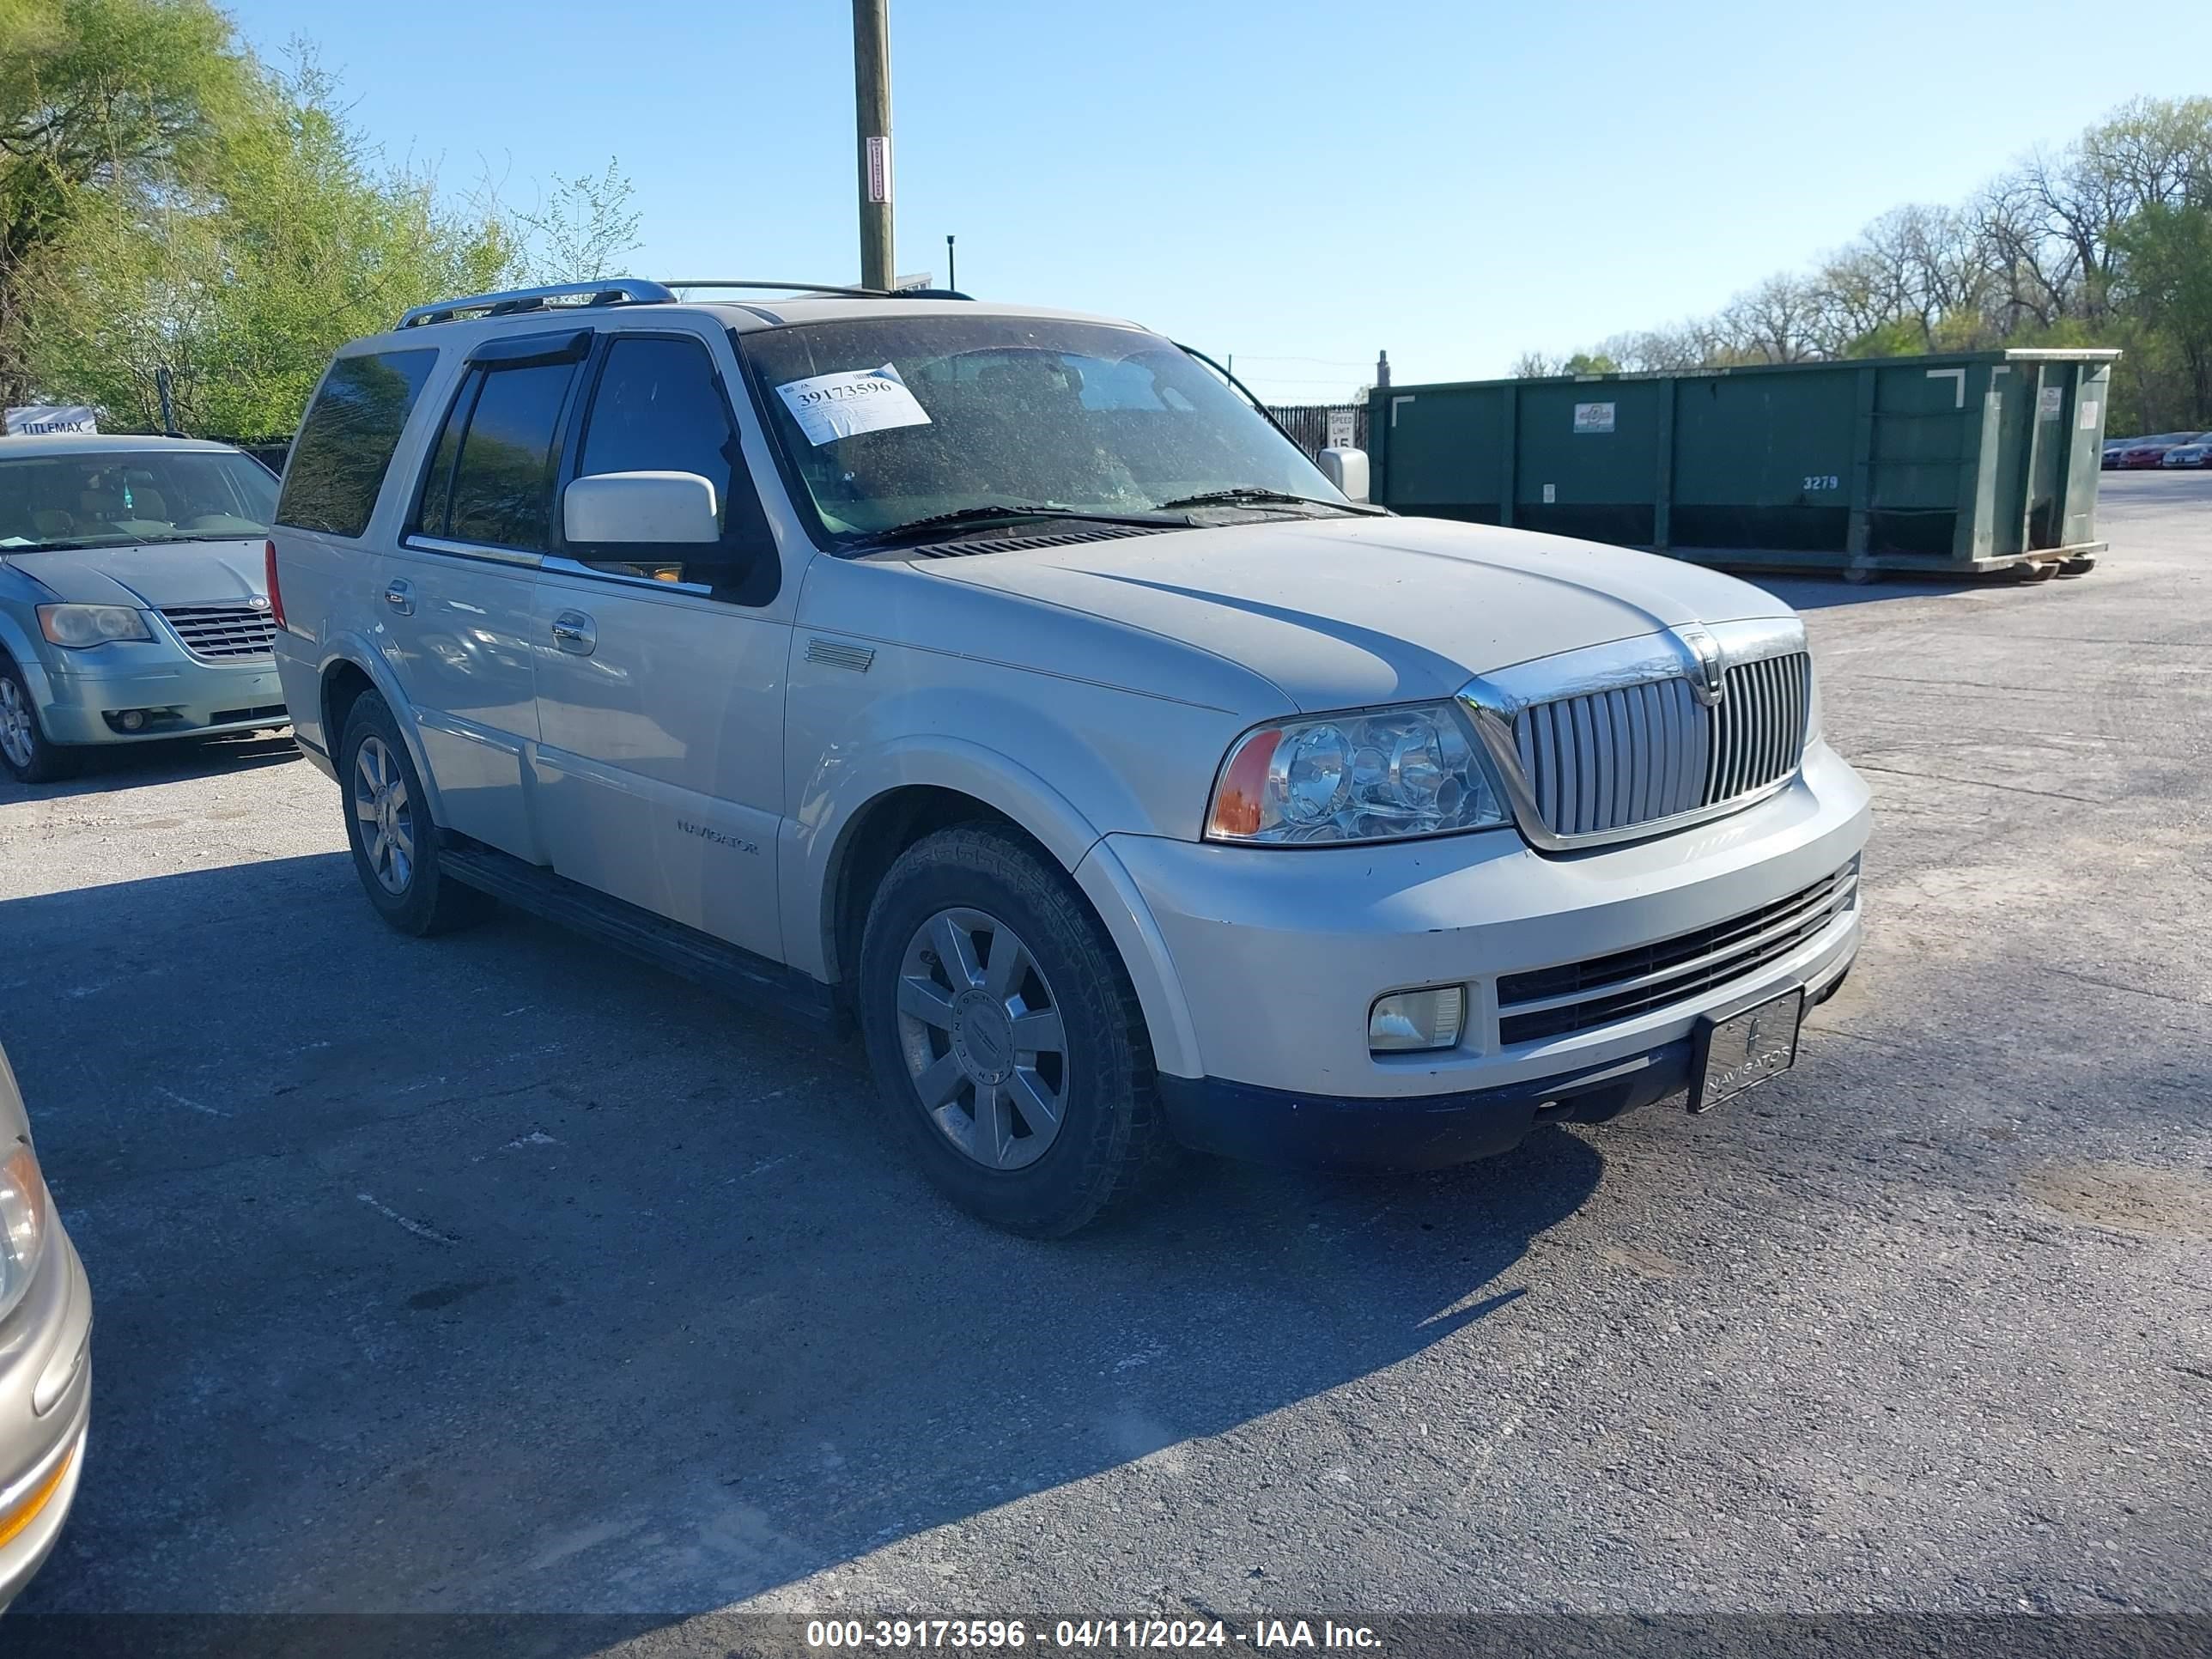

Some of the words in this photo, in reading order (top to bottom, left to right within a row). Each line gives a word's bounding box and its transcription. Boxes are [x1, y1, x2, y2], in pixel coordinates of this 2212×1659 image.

[798, 380, 892, 407] 39173596
[1331, 416, 1352, 425] SPEED
[21, 422, 83, 434] TITLEMAX
[1333, 427, 1349, 435] LIMIT
[1333, 438, 1349, 448] 15
[1803, 475, 1838, 489] 3279
[676, 817, 760, 856] NAVIGATOR
[1707, 1045, 1790, 1091] NAVIGATOR
